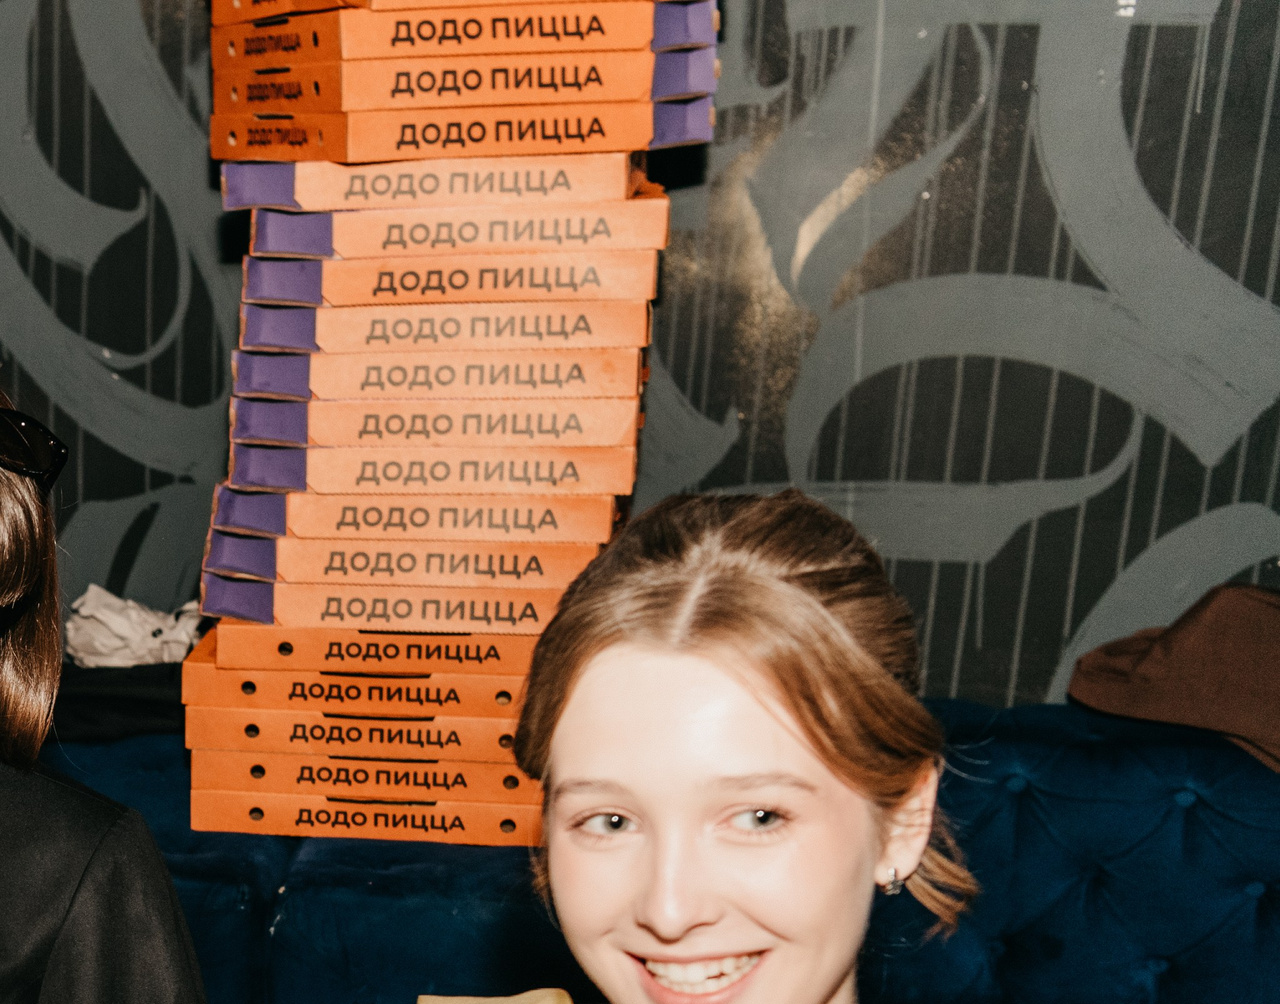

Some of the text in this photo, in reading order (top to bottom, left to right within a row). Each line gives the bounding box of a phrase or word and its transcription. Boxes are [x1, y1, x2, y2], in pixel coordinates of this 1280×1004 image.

[391, 16, 604, 46] ДОДО ПИЦЦА
[391, 66, 602, 97] ДОДО ПИЦЦА
[397, 118, 605, 149] ДОДО ПИЦЦА
[344, 170, 571, 200] ДОДО ПИЦЦА
[382, 217, 611, 250] ДОДО ПИЦЦА
[373, 268, 599, 296] ДОДО ПИЦЦА
[365, 314, 592, 345] ДОДО ПИЦЦА
[360, 363, 586, 391] ДОДО ПИЦЦА
[358, 414, 582, 439] ДОДО ПИЦЦА
[356, 461, 580, 486] ДОДО ПИЦЦА
[336, 506, 558, 533] ДОДО ПИЦЦА
[324, 551, 543, 579] ДОДО ПИЦЦА
[321, 597, 539, 625] ДОДО ПИЦЦА
[325, 642, 500, 663] ДОДО ПИЦЦА
[289, 682, 460, 706] ДОДО ПИЦЦА
[290, 724, 461, 748] ДОДО ПИЦЦА
[297, 766, 467, 790] ДОДО ПИЦЦА
[295, 809, 465, 832] ДОДО ПИЦЦА
